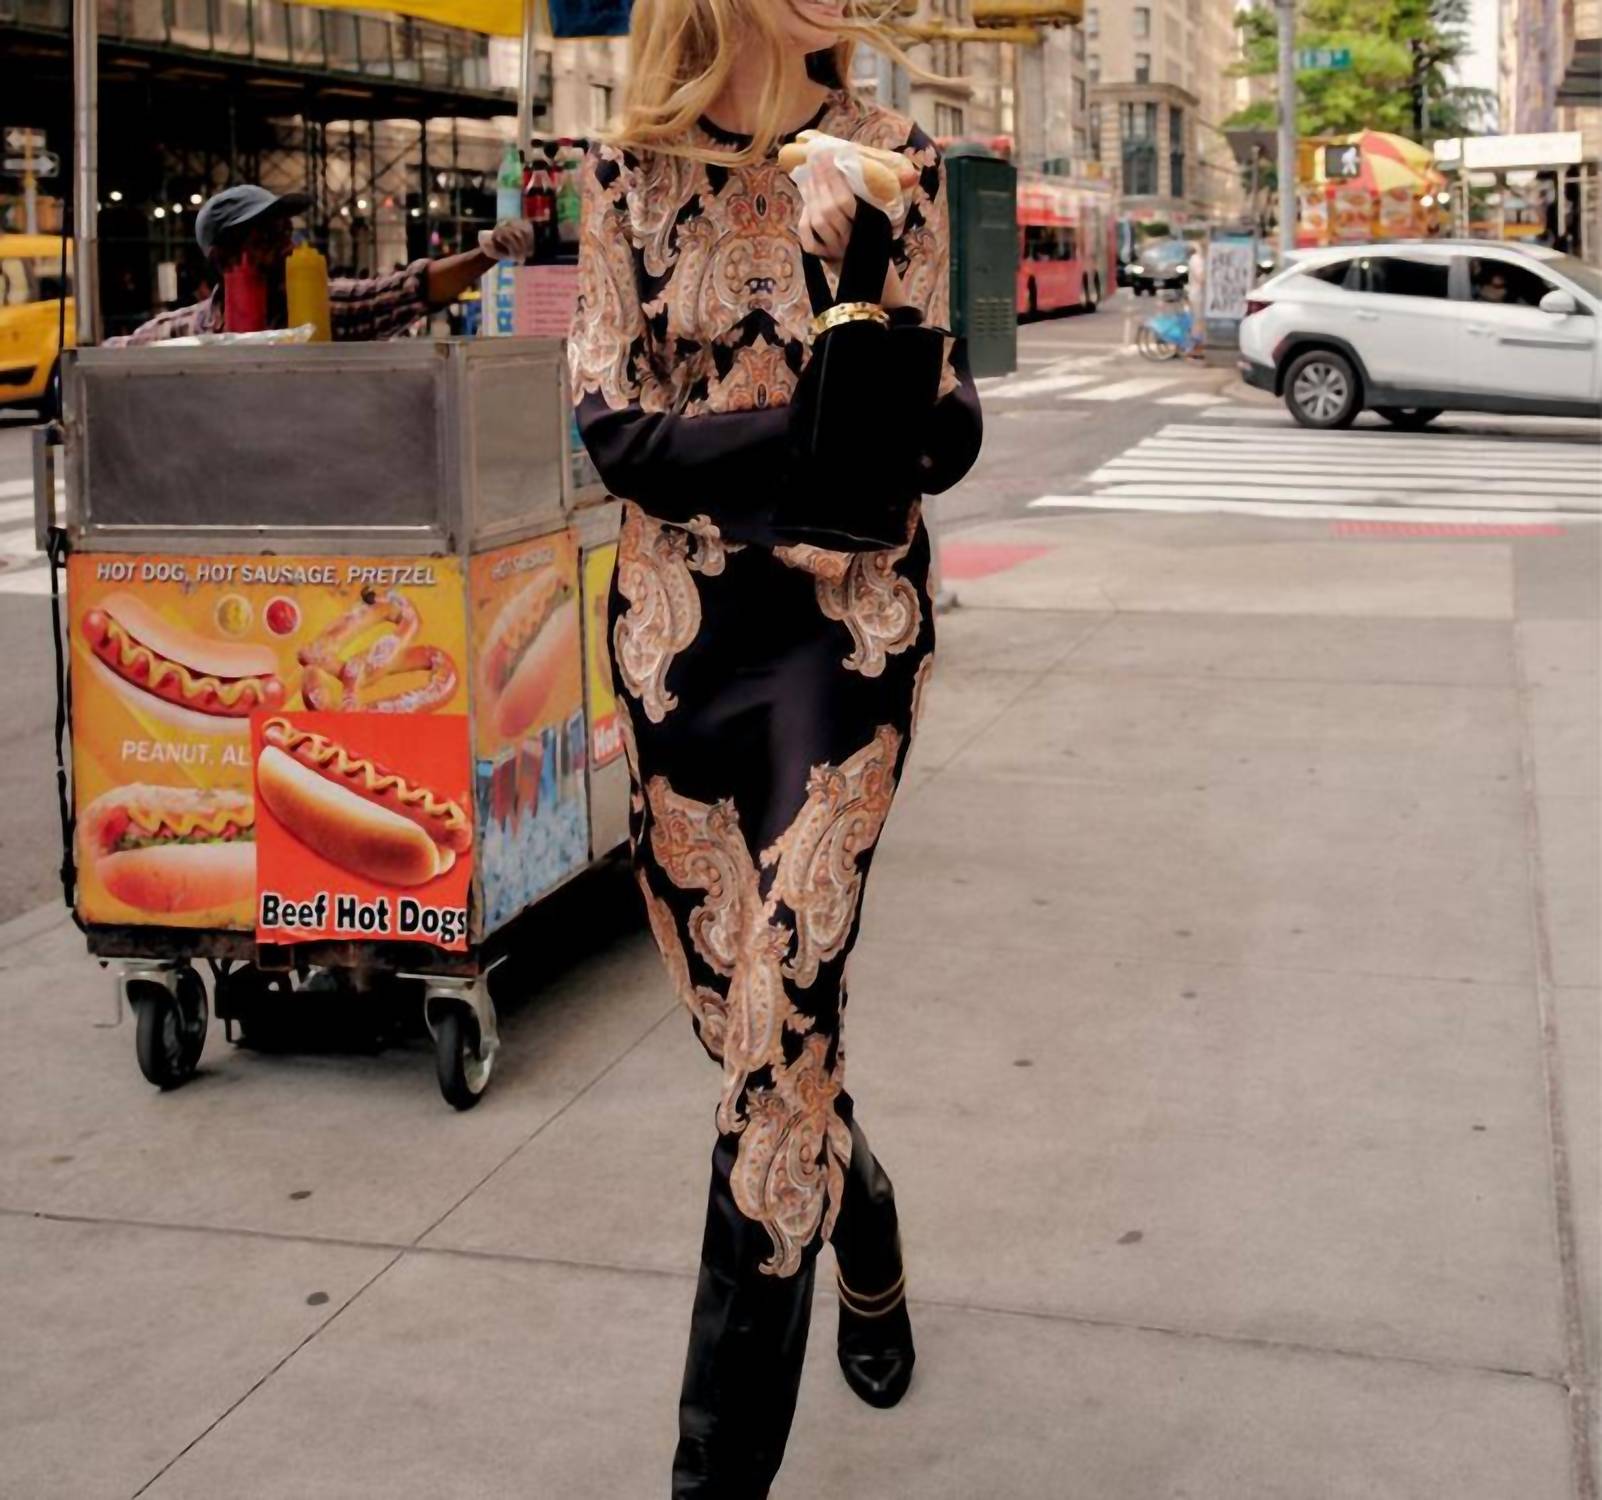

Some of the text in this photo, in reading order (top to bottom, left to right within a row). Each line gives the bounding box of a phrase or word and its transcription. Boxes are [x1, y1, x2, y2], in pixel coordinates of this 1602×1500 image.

[96, 561, 136, 581] HOT
[197, 563, 237, 582] HOT
[241, 564, 341, 586] SAUSAGE,
[346, 565, 437, 585] PRETZEL
[261, 893, 466, 944] Beef Hot Dogs
